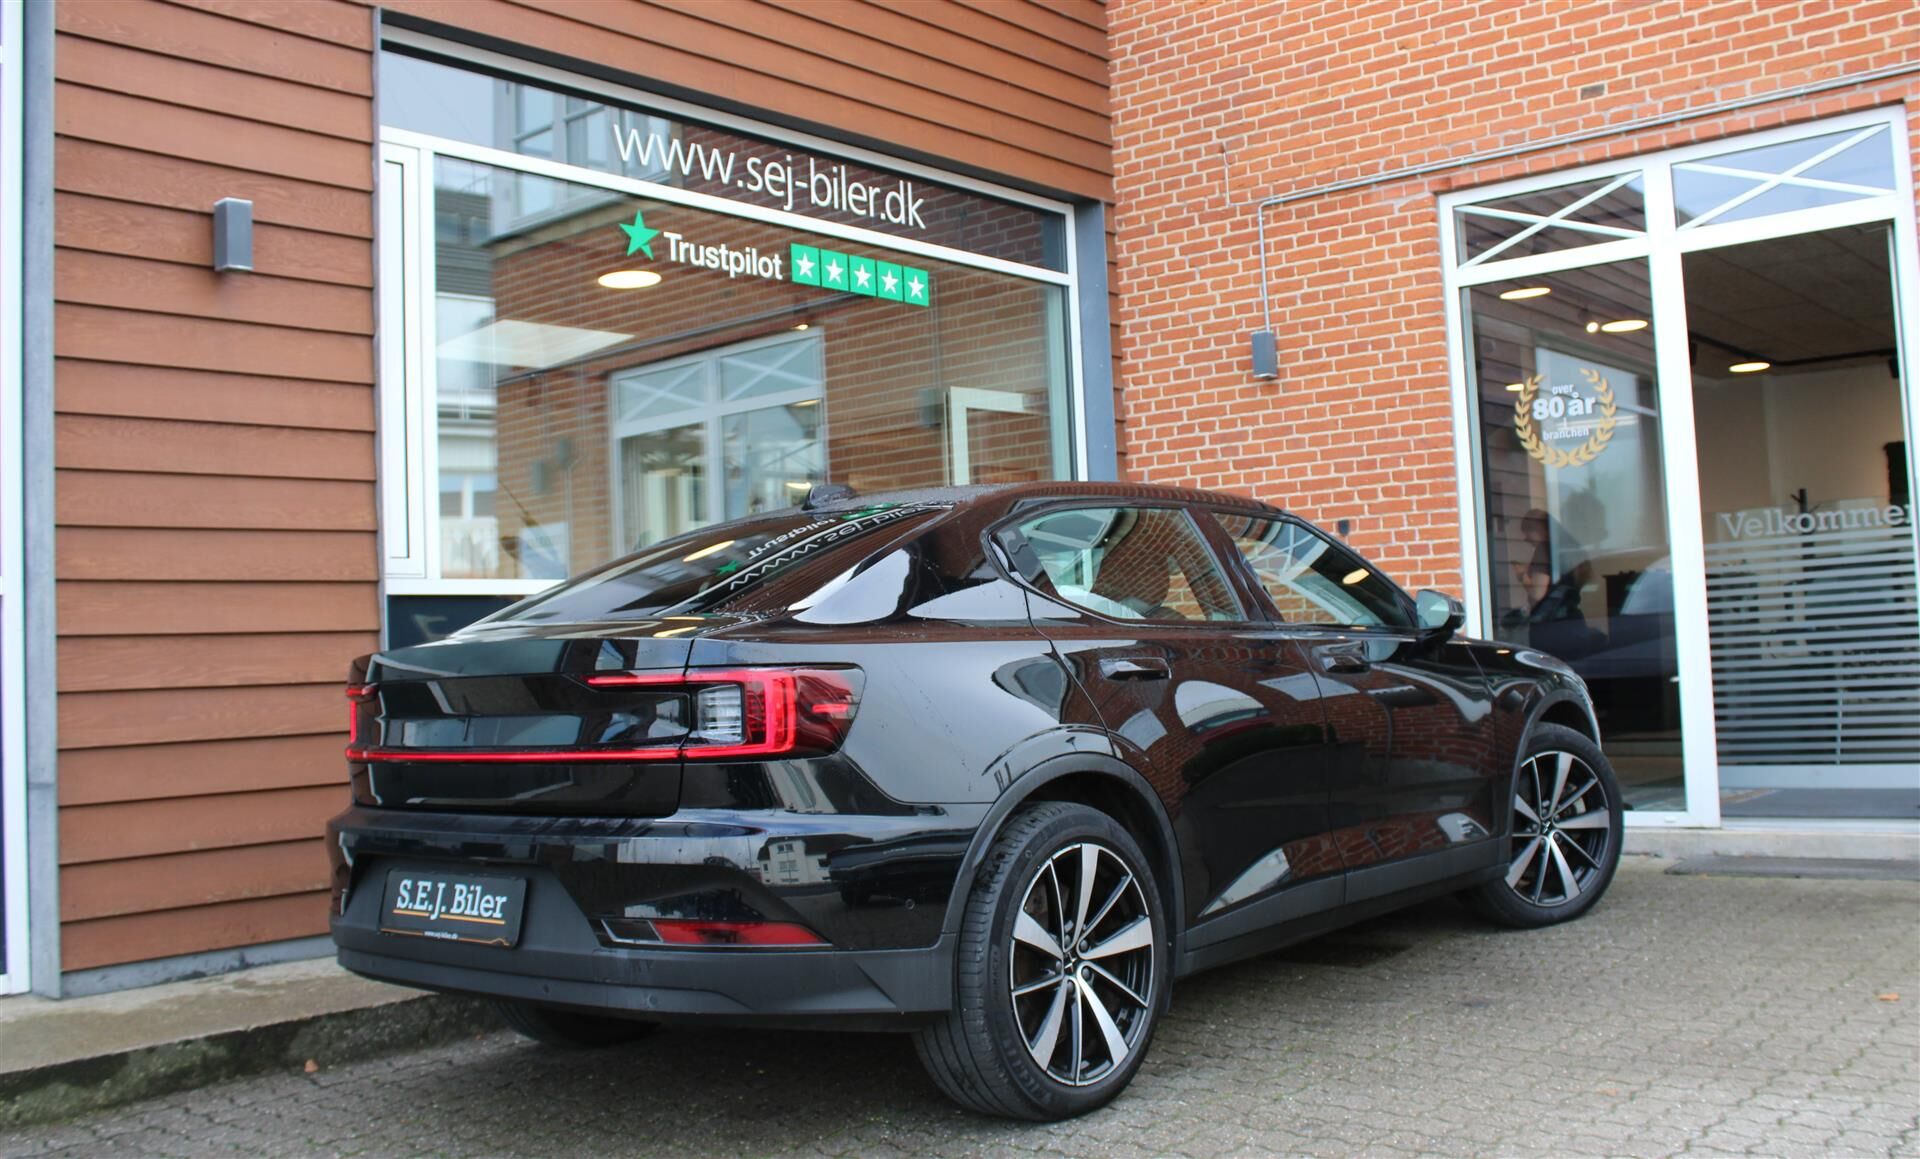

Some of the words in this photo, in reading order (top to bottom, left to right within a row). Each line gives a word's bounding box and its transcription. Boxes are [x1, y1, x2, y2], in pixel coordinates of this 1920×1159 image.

[613, 123, 926, 229] www.sej-biler.dk
[663, 231, 784, 280] Trustpilot
[1532, 396, 1565, 420] 80
[1568, 391, 1596, 416] år
[1552, 383, 1575, 395] over
[1542, 427, 1590, 441] branchen
[396, 879, 447, 920] S.E.J.
[450, 883, 508, 918] Biler
